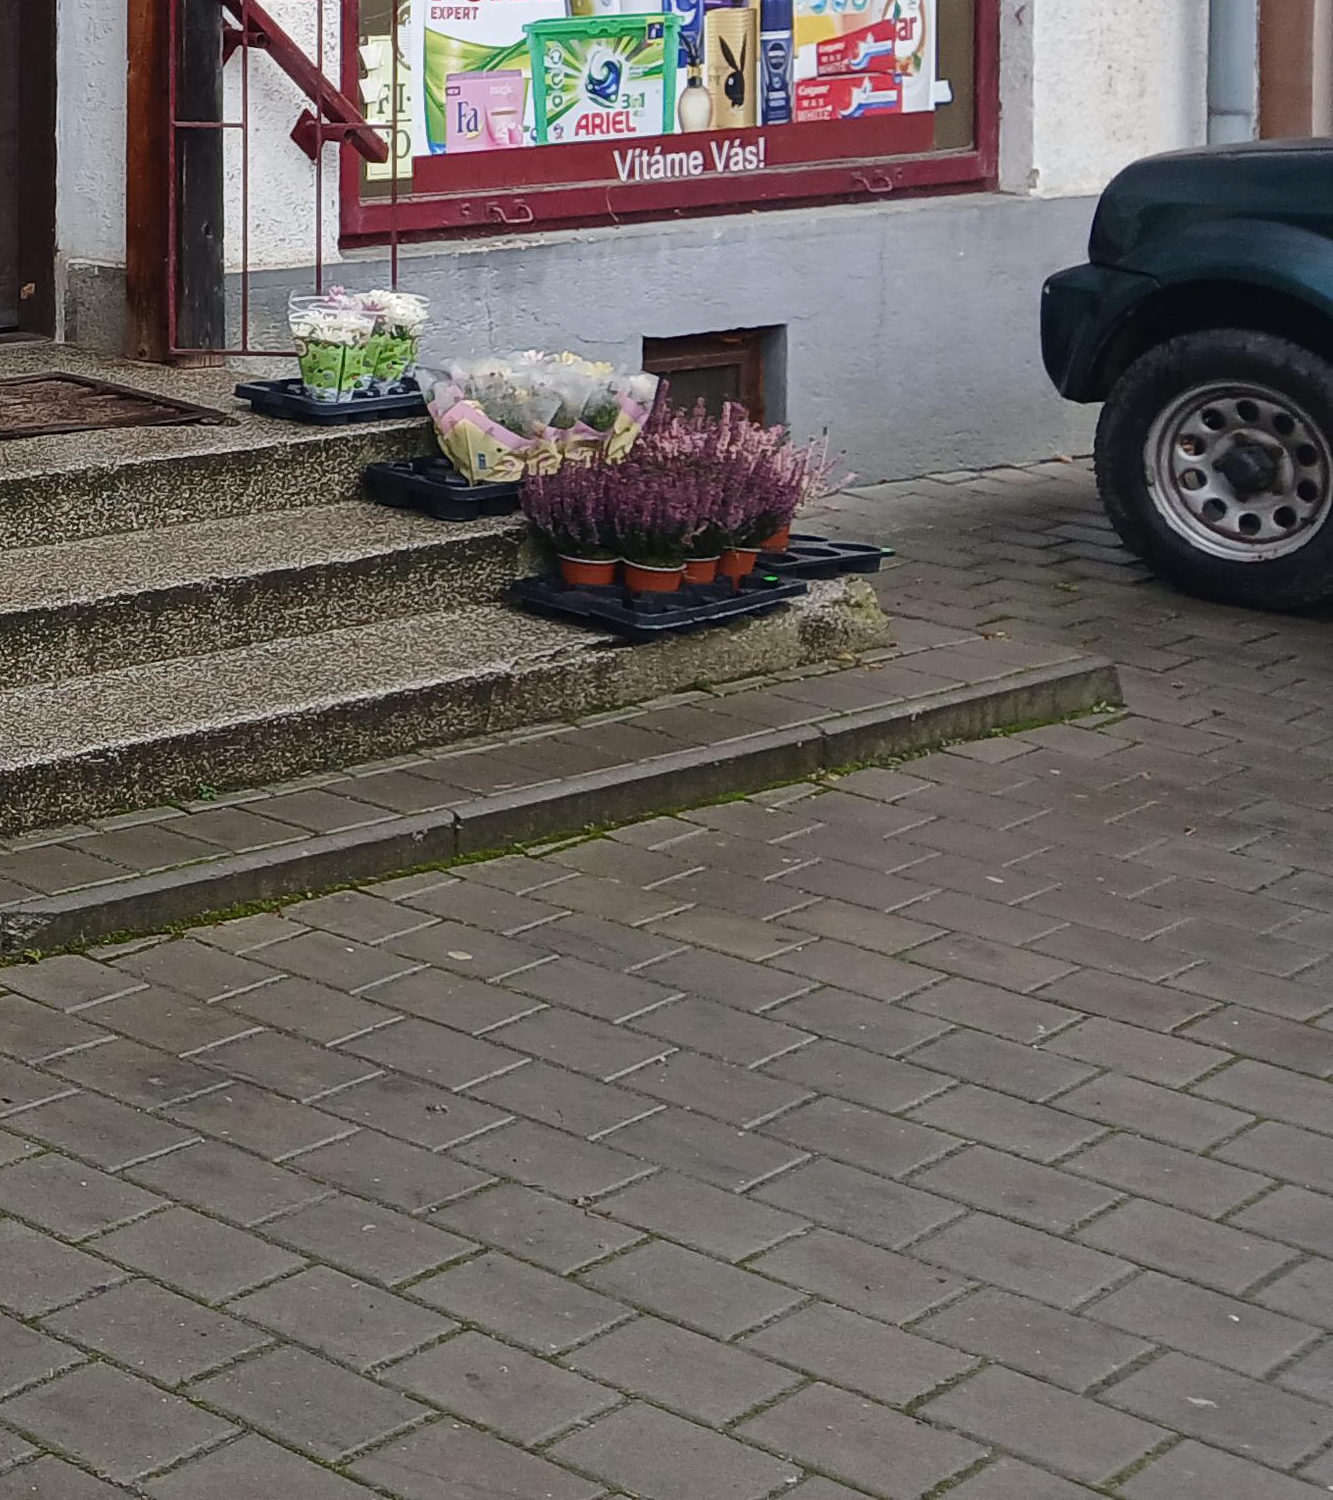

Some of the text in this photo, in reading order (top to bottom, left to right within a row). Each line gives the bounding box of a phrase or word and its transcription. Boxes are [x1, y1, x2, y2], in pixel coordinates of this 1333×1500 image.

[430, 6, 479, 20] EXPERT
[457, 101, 479, 133] Fa
[575, 110, 637, 136] ARIEL
[612, 136, 766, 182] Vítáme Vás!
